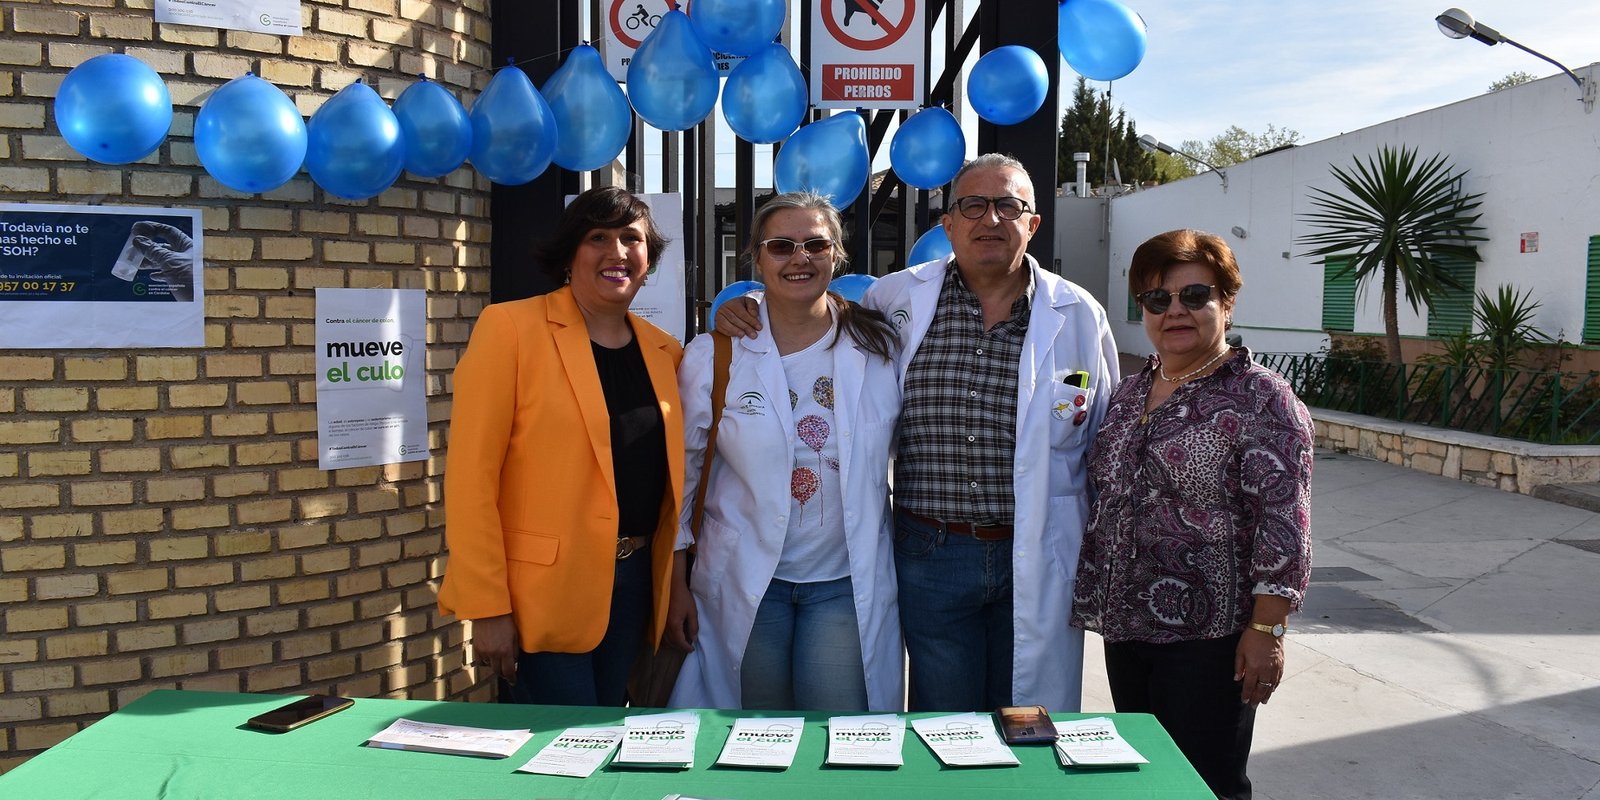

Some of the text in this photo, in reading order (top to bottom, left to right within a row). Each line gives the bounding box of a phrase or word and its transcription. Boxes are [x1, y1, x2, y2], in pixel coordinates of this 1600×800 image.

[834, 67, 902, 80] PROHIBIDO
[844, 85, 892, 98] PERROS
[56, 225, 72, 234] no
[75, 224, 89, 234] te
[20, 234, 61, 245] hecho
[64, 236, 78, 246] el
[22, 282, 40, 290] 00
[42, 282, 57, 292] 17
[60, 282, 76, 292] 37
[327, 340, 403, 358] mueve
[326, 360, 404, 382] el culo
[926, 730, 979, 738] mueve
[573, 742, 608, 750] culo
